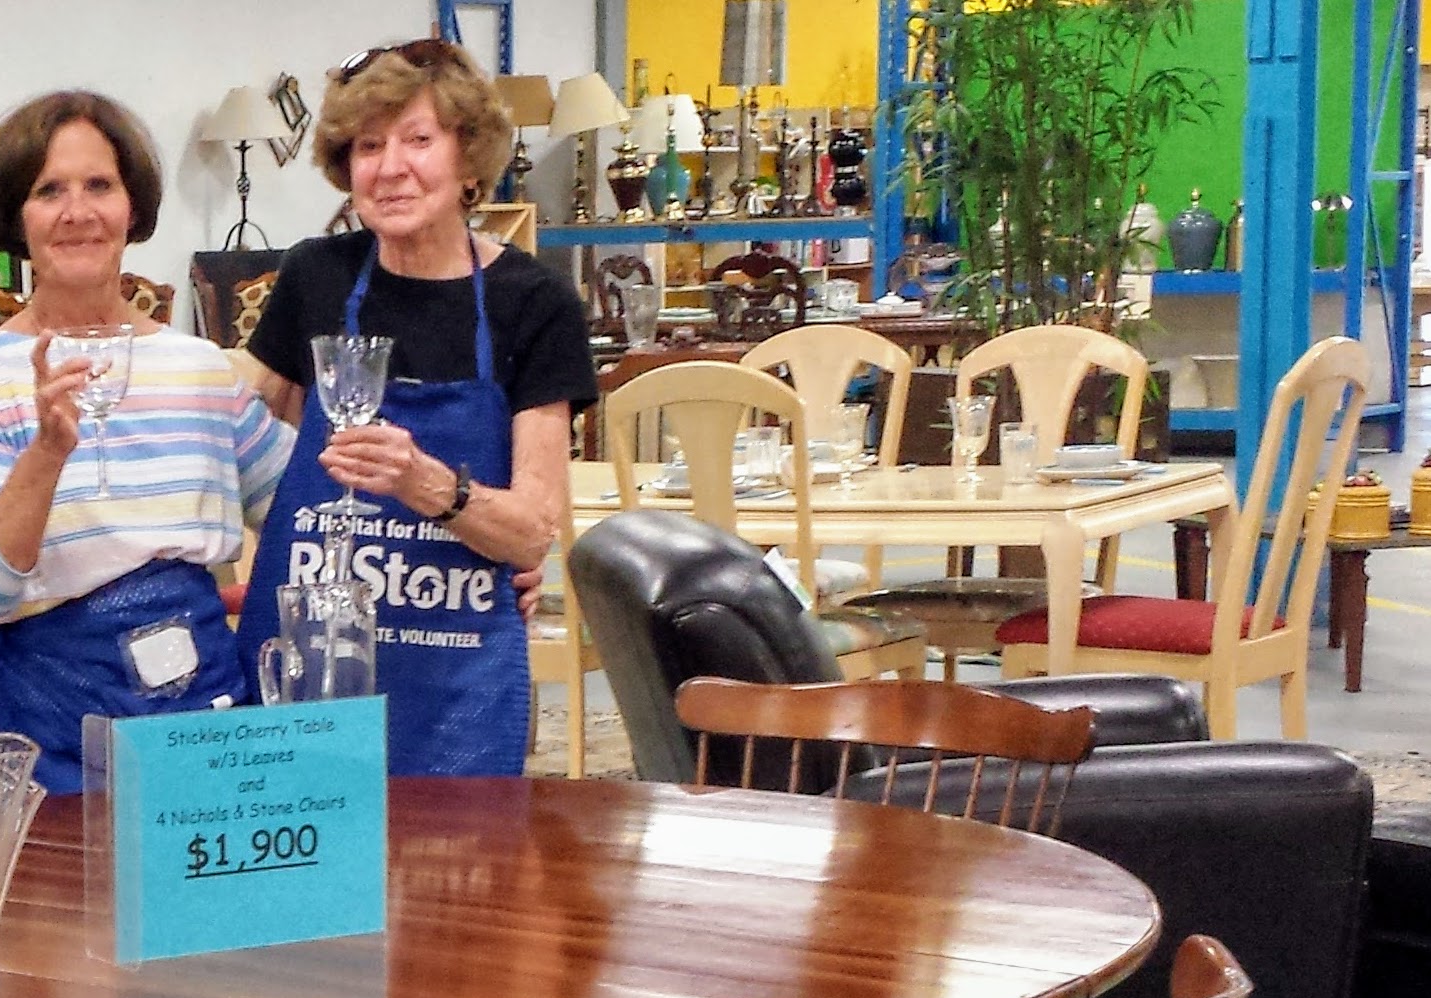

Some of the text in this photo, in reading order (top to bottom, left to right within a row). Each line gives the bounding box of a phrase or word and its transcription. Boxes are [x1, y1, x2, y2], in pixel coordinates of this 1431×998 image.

[386, 518, 416, 538] for
[289, 541, 494, 613] RStore
[167, 716, 335, 747] Stickley Cherry Table
[207, 749, 295, 769] w/3 Leaves
[238, 775, 266, 793] and
[155, 793, 346, 826] 4 Nichols & Stone Chairs
[187, 824, 318, 876] $1,900
